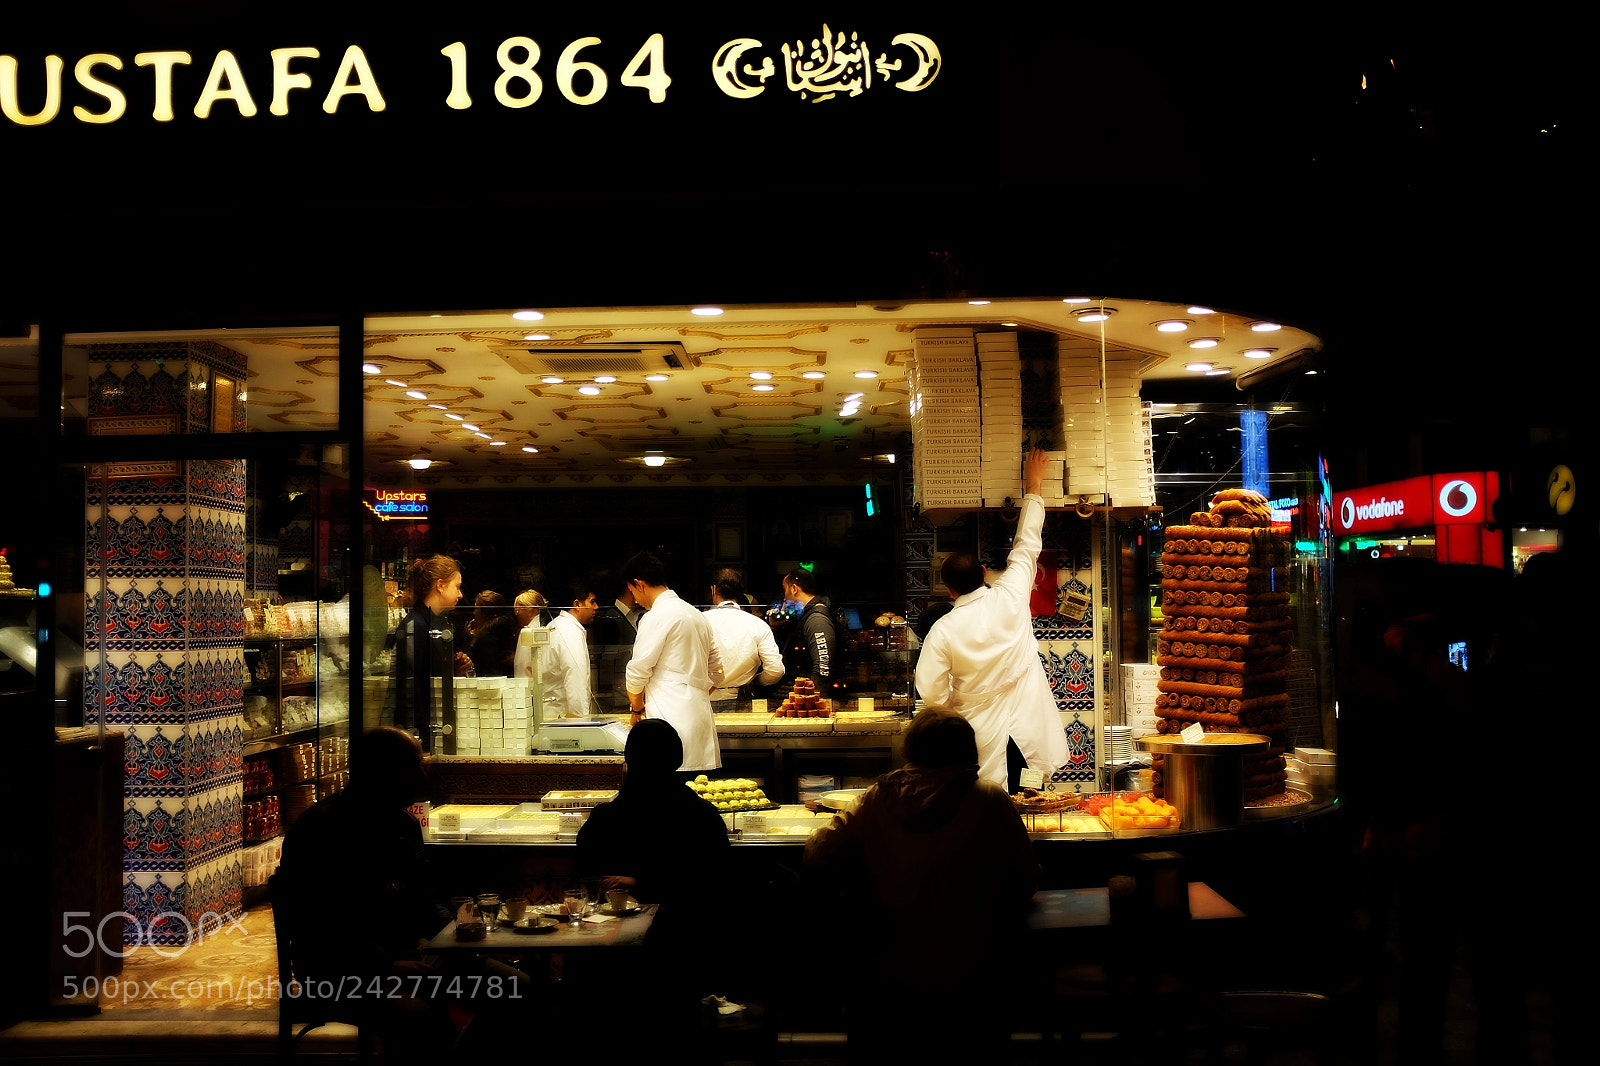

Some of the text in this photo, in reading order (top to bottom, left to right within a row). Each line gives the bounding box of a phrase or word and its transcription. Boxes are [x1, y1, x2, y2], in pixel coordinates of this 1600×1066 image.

[0, 32, 672, 126] USTAFA 1864
[375, 501, 429, 513] cafe salon
[1356, 496, 1404, 520] vodafone
